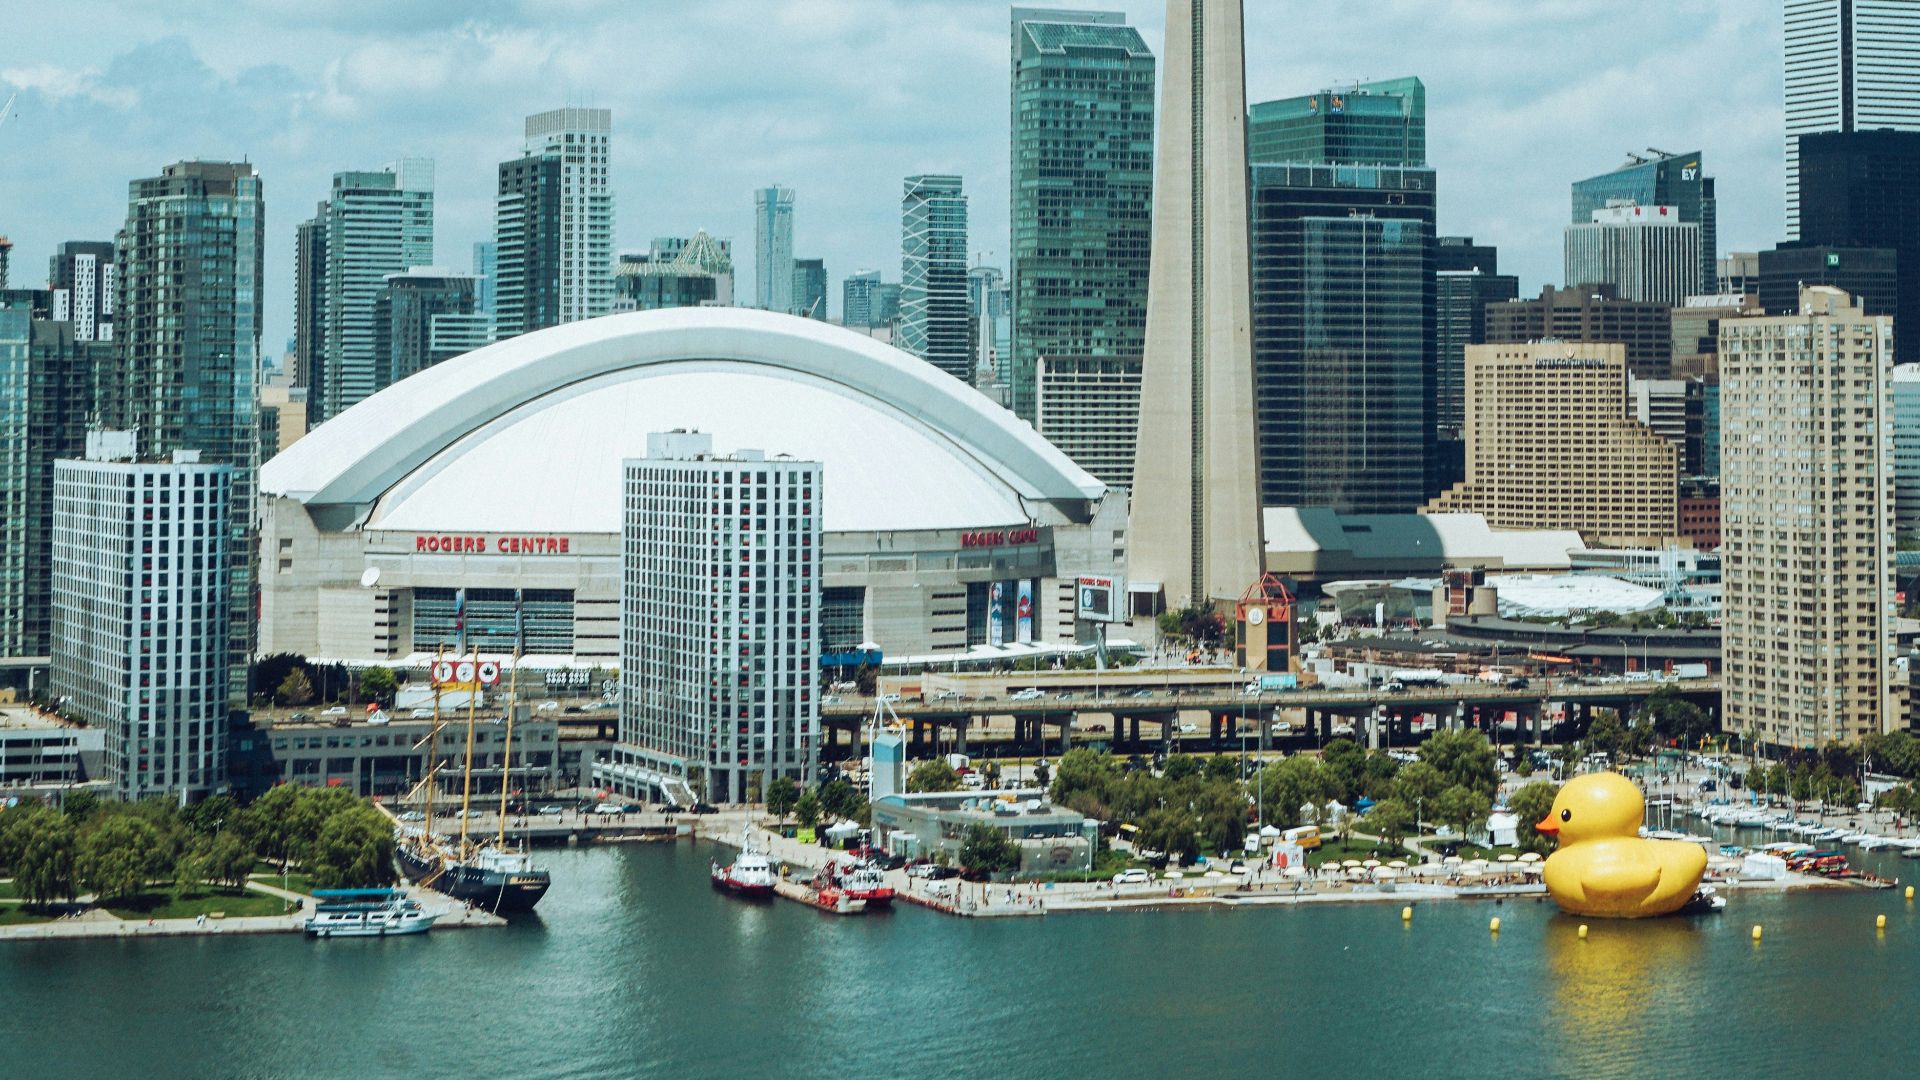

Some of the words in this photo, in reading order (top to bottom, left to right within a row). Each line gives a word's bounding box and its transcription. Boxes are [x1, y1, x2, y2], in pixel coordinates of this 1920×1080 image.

[1681, 168, 1697, 181] EY
[416, 535, 486, 553] ROGERS
[497, 536, 570, 554] CENTRE
[962, 530, 1004, 547] ROGERS
